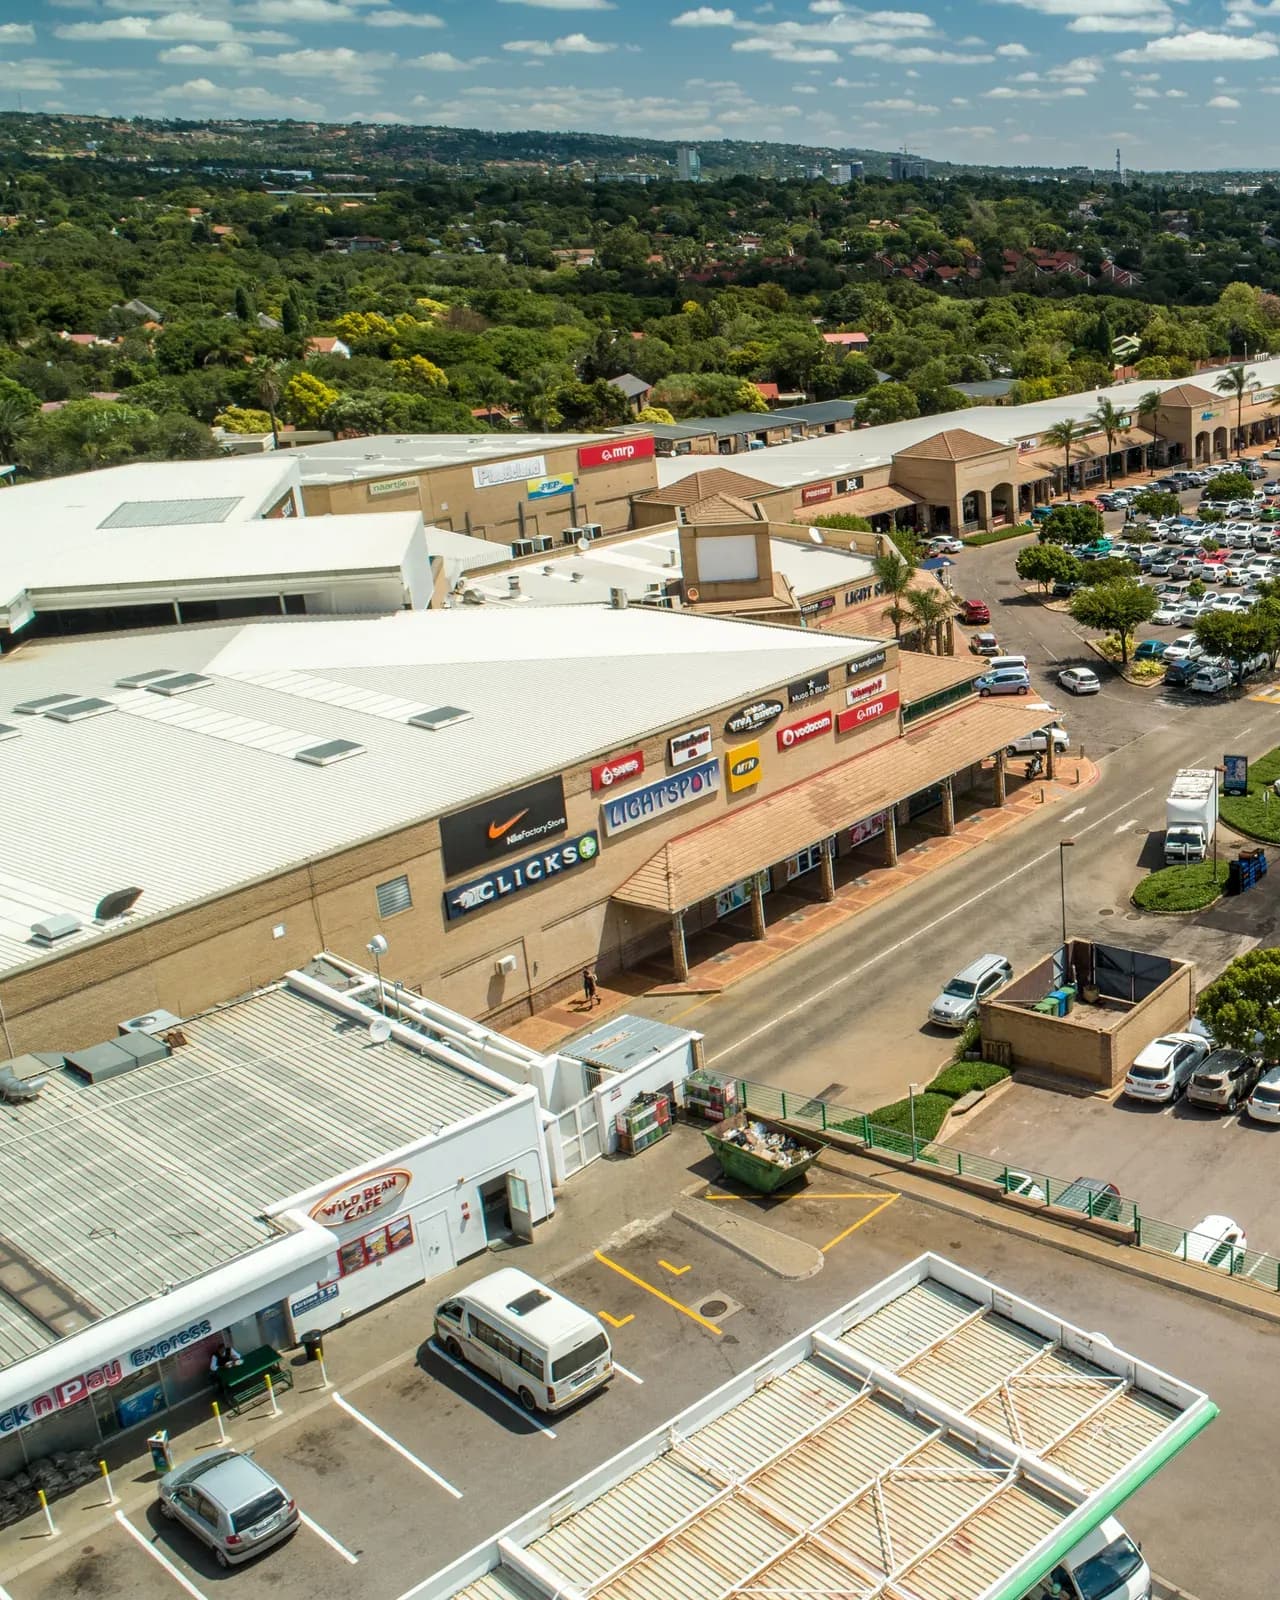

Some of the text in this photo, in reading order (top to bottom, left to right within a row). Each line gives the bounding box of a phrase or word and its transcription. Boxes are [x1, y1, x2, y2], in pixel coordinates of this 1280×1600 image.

[612, 444, 635, 459] mrp
[540, 480, 559, 491] PEP
[865, 702, 884, 717] mrp
[735, 758, 755, 775] MTN
[480, 845, 578, 901] CLICKS
[363, 1175, 398, 1200] BEAN
[343, 1196, 383, 1221] CAFE
[0, 1403, 32, 1432] ck
[58, 1360, 124, 1406] Pay
[130, 1318, 212, 1368] Express
